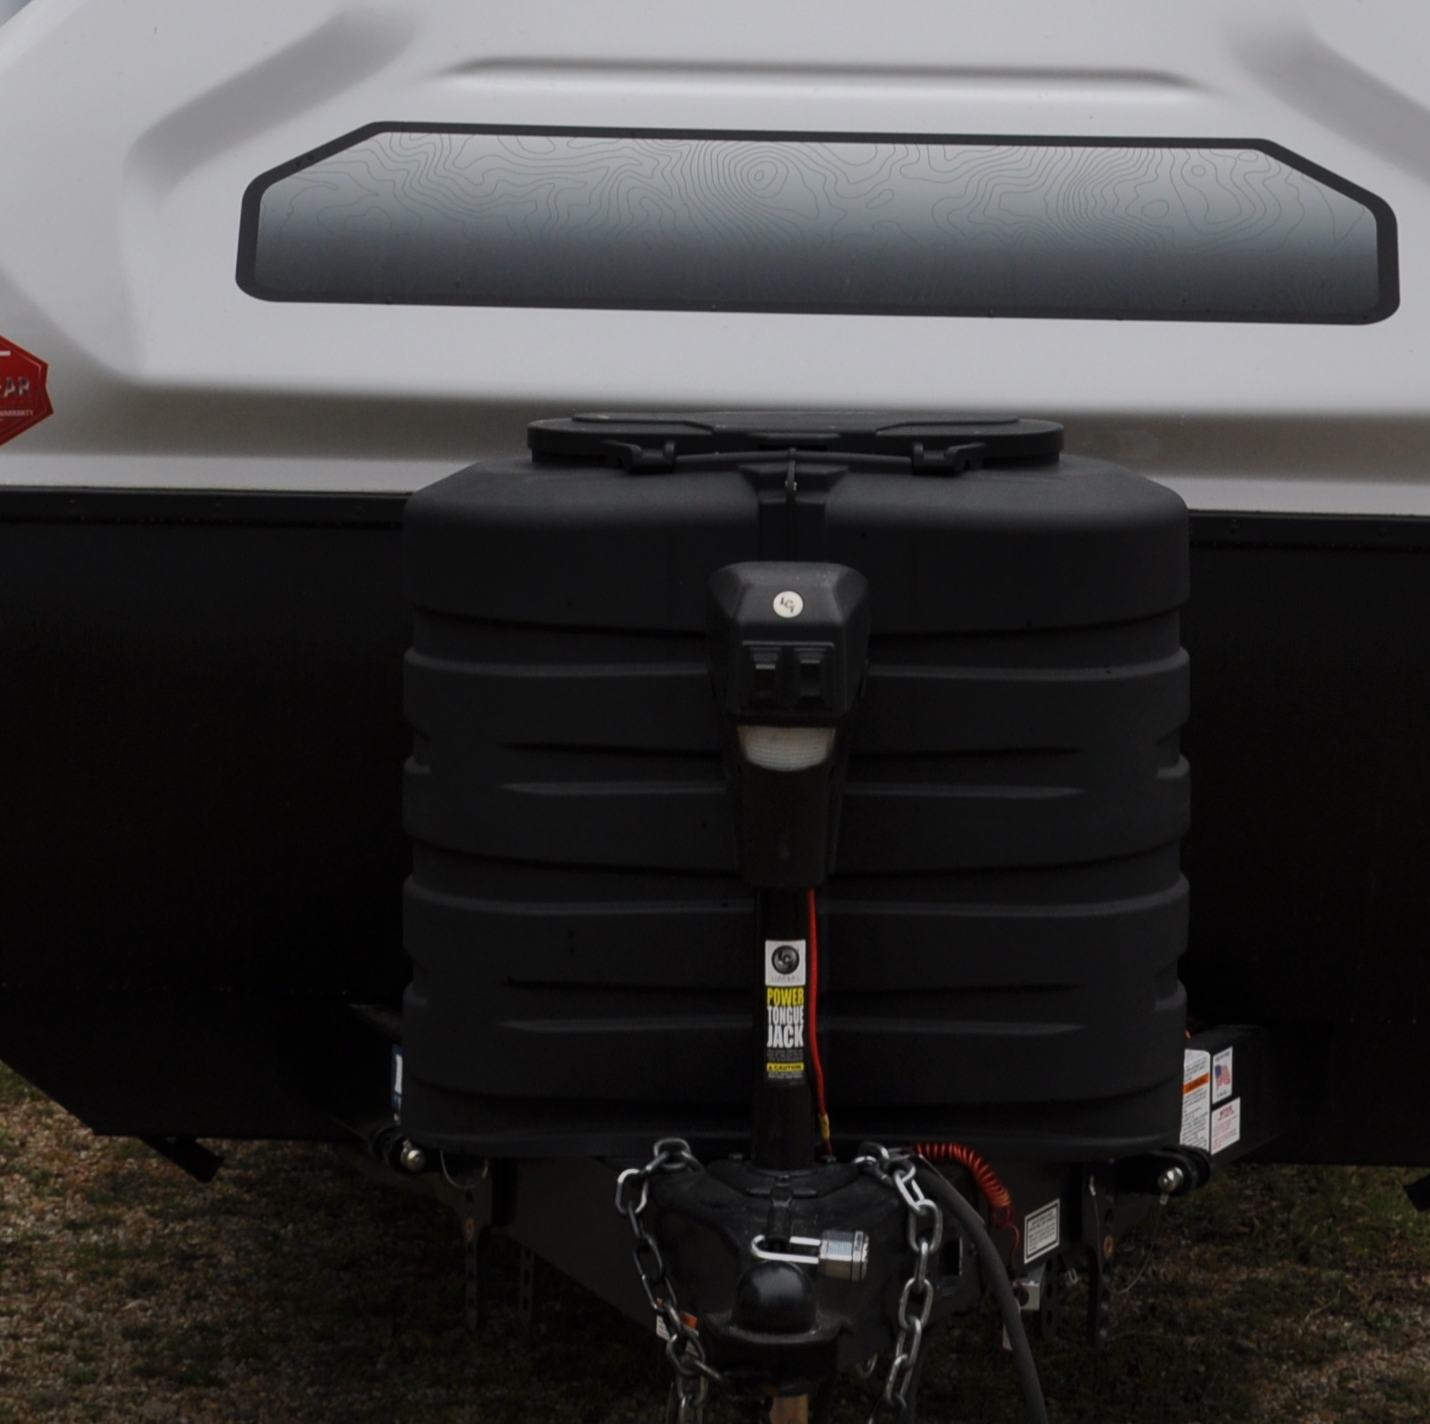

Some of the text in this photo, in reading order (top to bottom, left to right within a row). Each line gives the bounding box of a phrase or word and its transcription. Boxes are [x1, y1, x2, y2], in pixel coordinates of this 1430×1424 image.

[767, 987, 804, 1006] POWER
[767, 1006, 804, 1025] TONGUE
[767, 1025, 804, 1048] JACK
